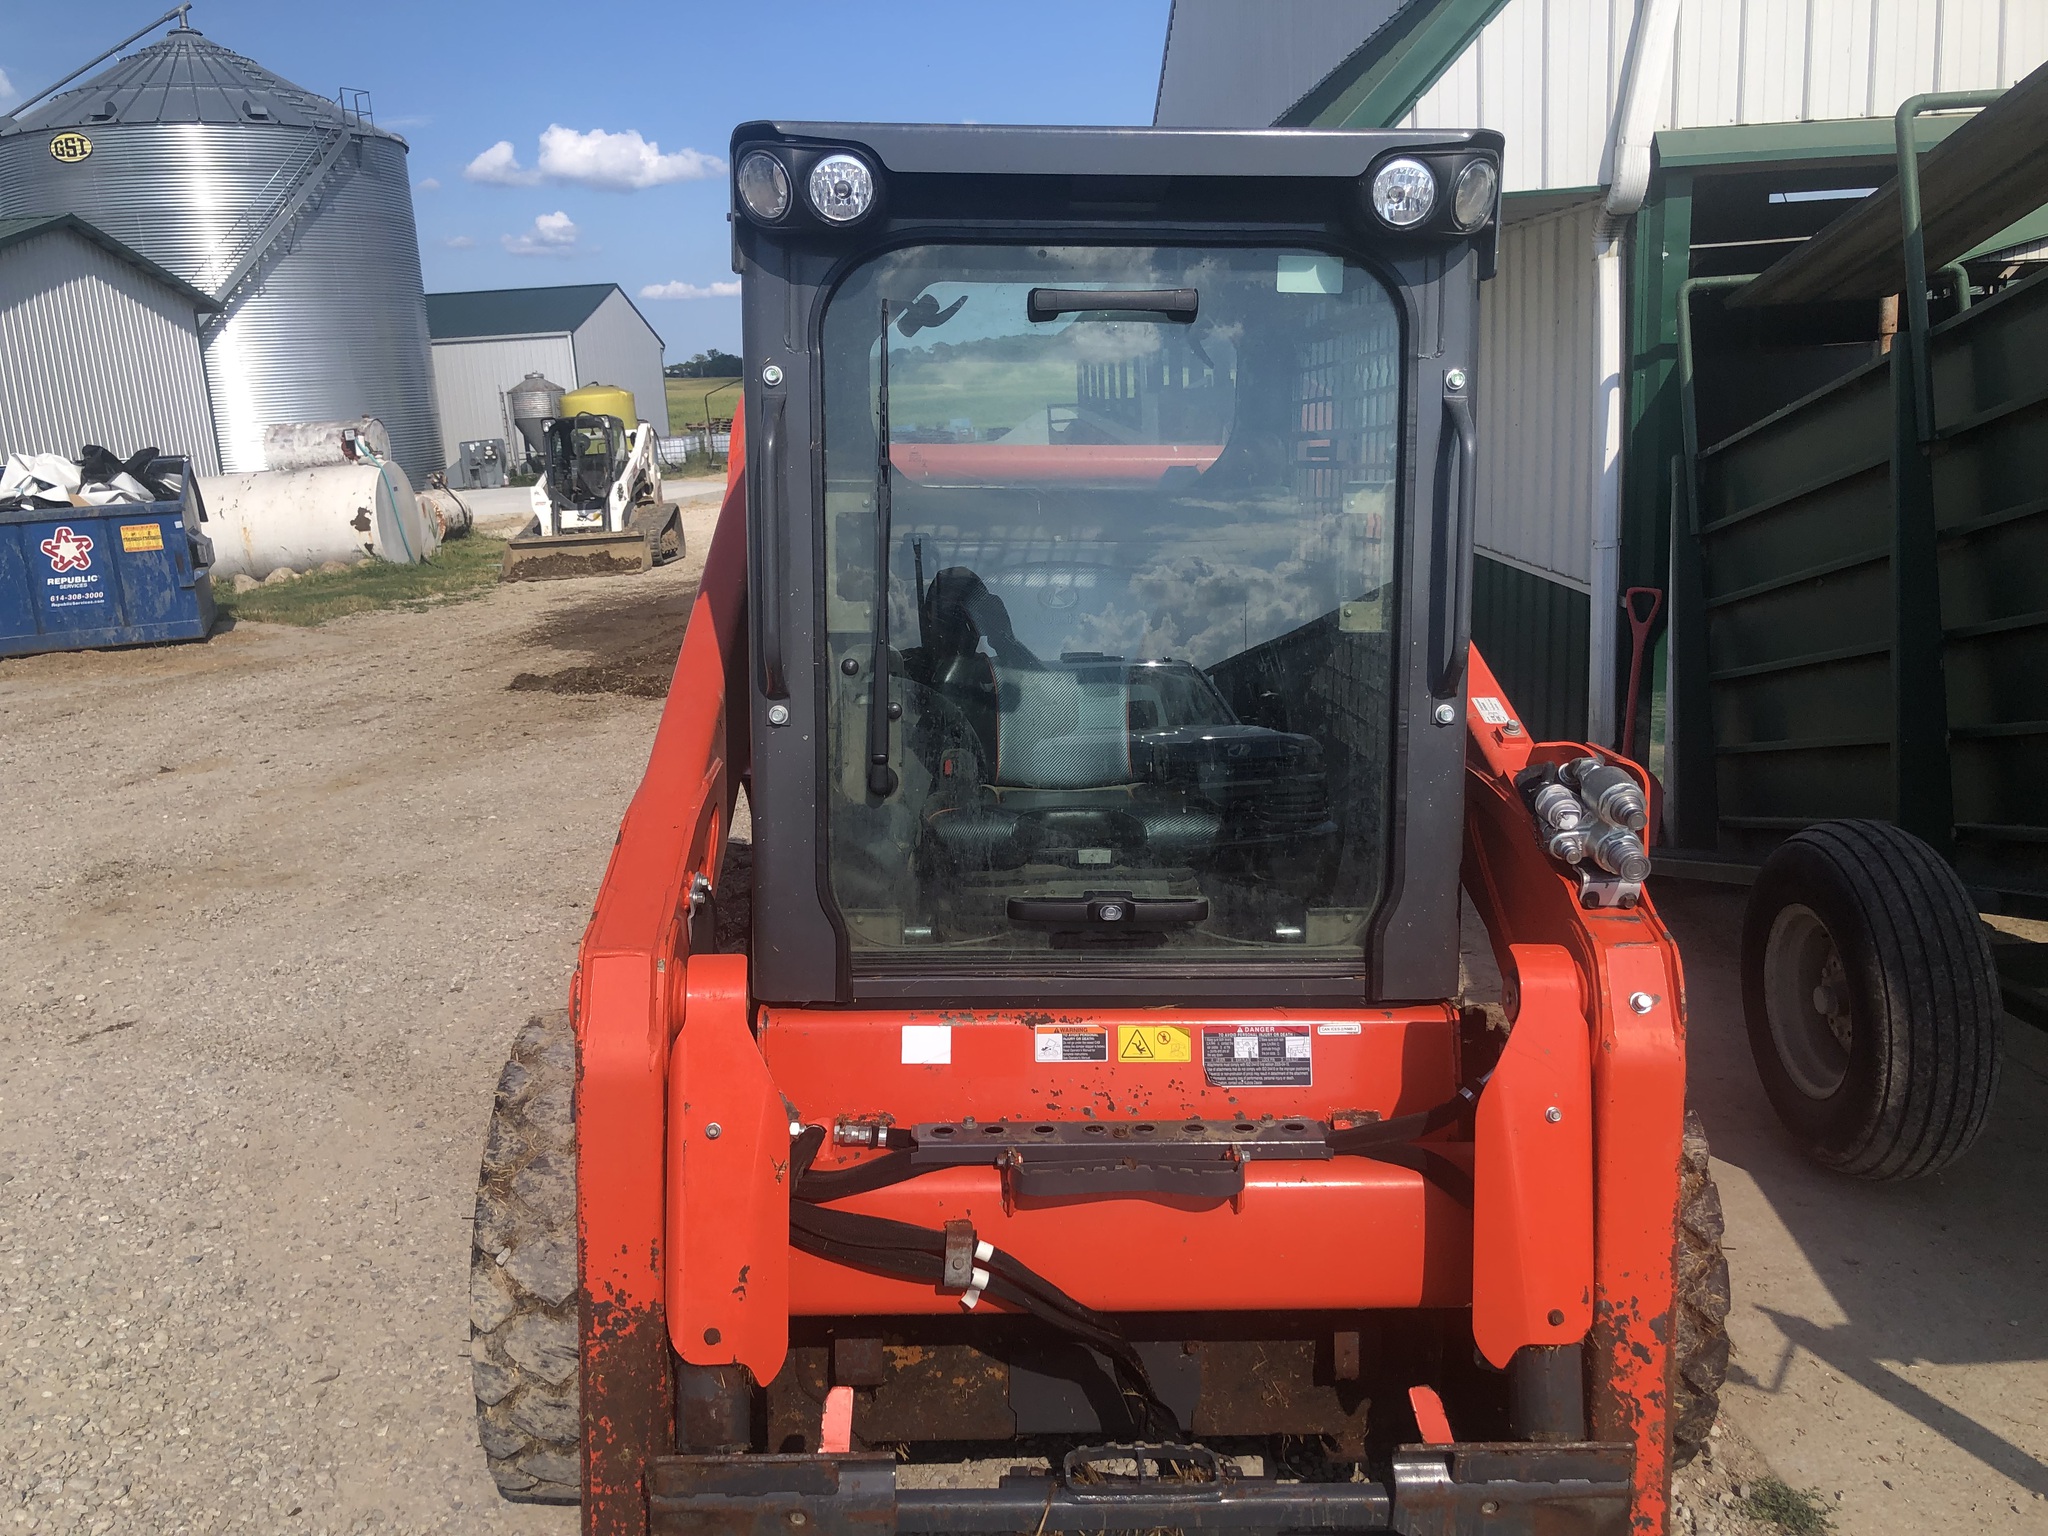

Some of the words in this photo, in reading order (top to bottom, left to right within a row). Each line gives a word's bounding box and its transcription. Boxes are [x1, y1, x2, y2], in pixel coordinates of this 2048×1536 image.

[54, 137, 88, 157] GSI
[47, 575, 98, 585] REPUBLIC
[50, 592, 104, 602] 614-308-3000
